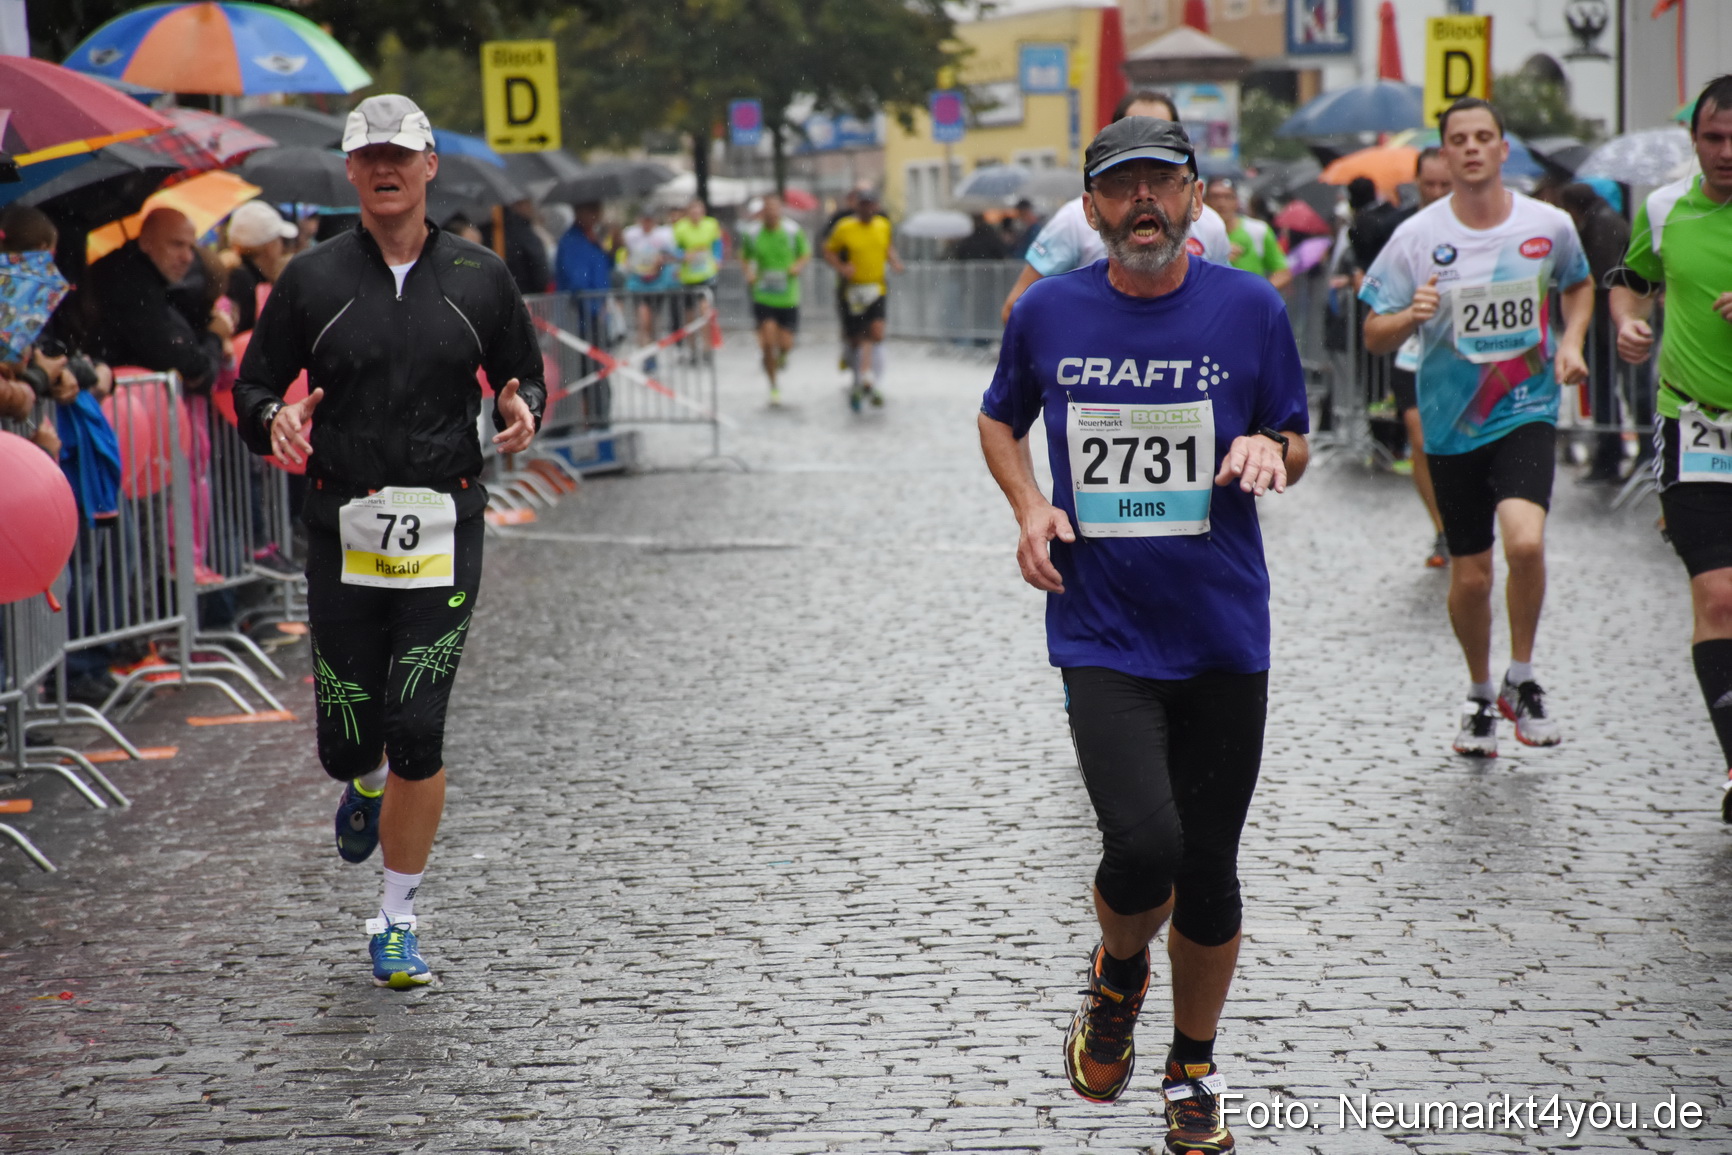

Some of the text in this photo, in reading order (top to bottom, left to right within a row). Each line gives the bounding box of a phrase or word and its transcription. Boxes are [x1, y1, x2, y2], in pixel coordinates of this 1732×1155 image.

[1433, 21, 1485, 40] Block
[1444, 50, 1474, 98] D
[505, 77, 539, 126] D
[1463, 297, 1534, 332] 2488
[1474, 336, 1527, 352] Christian
[1056, 357, 1193, 389] CRAFT
[1077, 418, 1123, 427] NeuerMarkt
[1130, 407, 1202, 424] BOCK
[1691, 421, 1732, 450] 21
[1082, 436, 1197, 485] 2731
[391, 491, 446, 505] BOCK
[1118, 498, 1167, 519] Hans
[376, 513, 421, 551] 73
[375, 558, 420, 575] Harald
